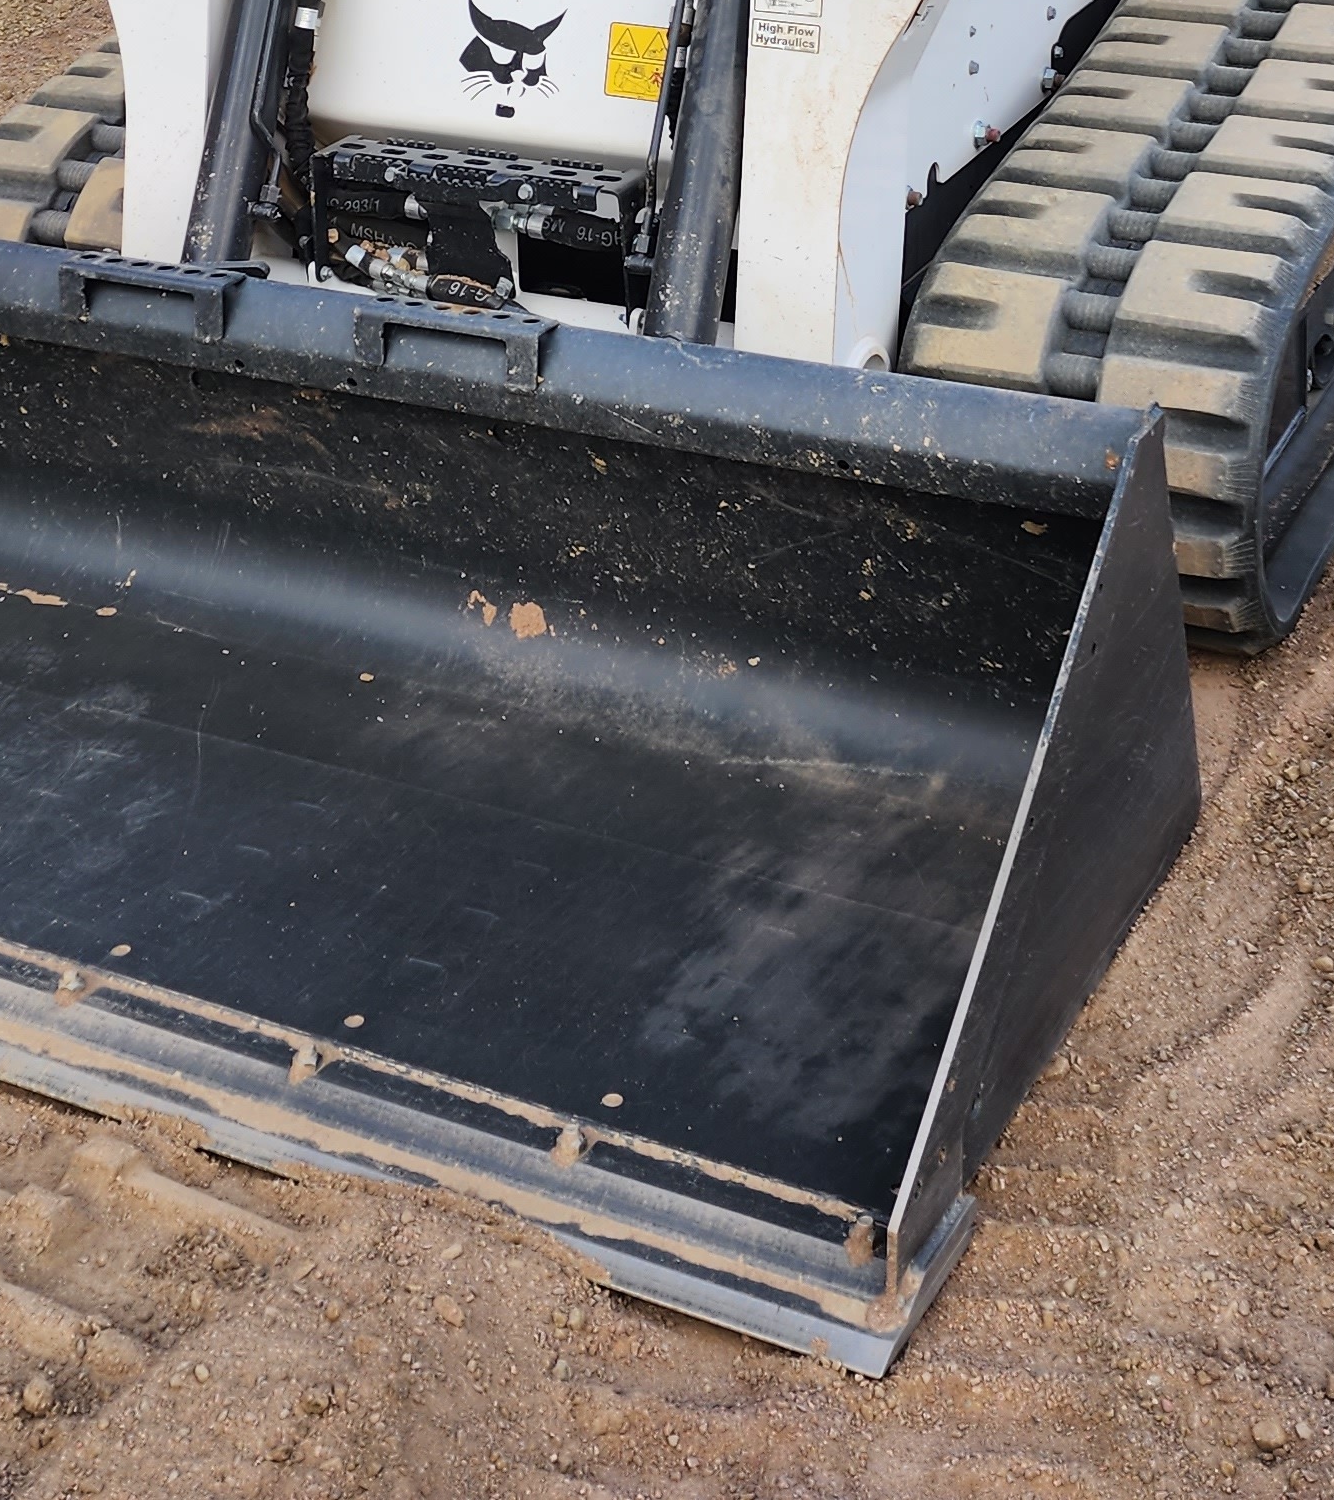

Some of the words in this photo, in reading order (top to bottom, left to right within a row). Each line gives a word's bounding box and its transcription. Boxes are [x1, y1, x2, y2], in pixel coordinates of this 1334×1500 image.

[758, 22, 784, 34] High
[787, 25, 814, 36] Flow
[755, 34, 815, 49] Hydraulics
